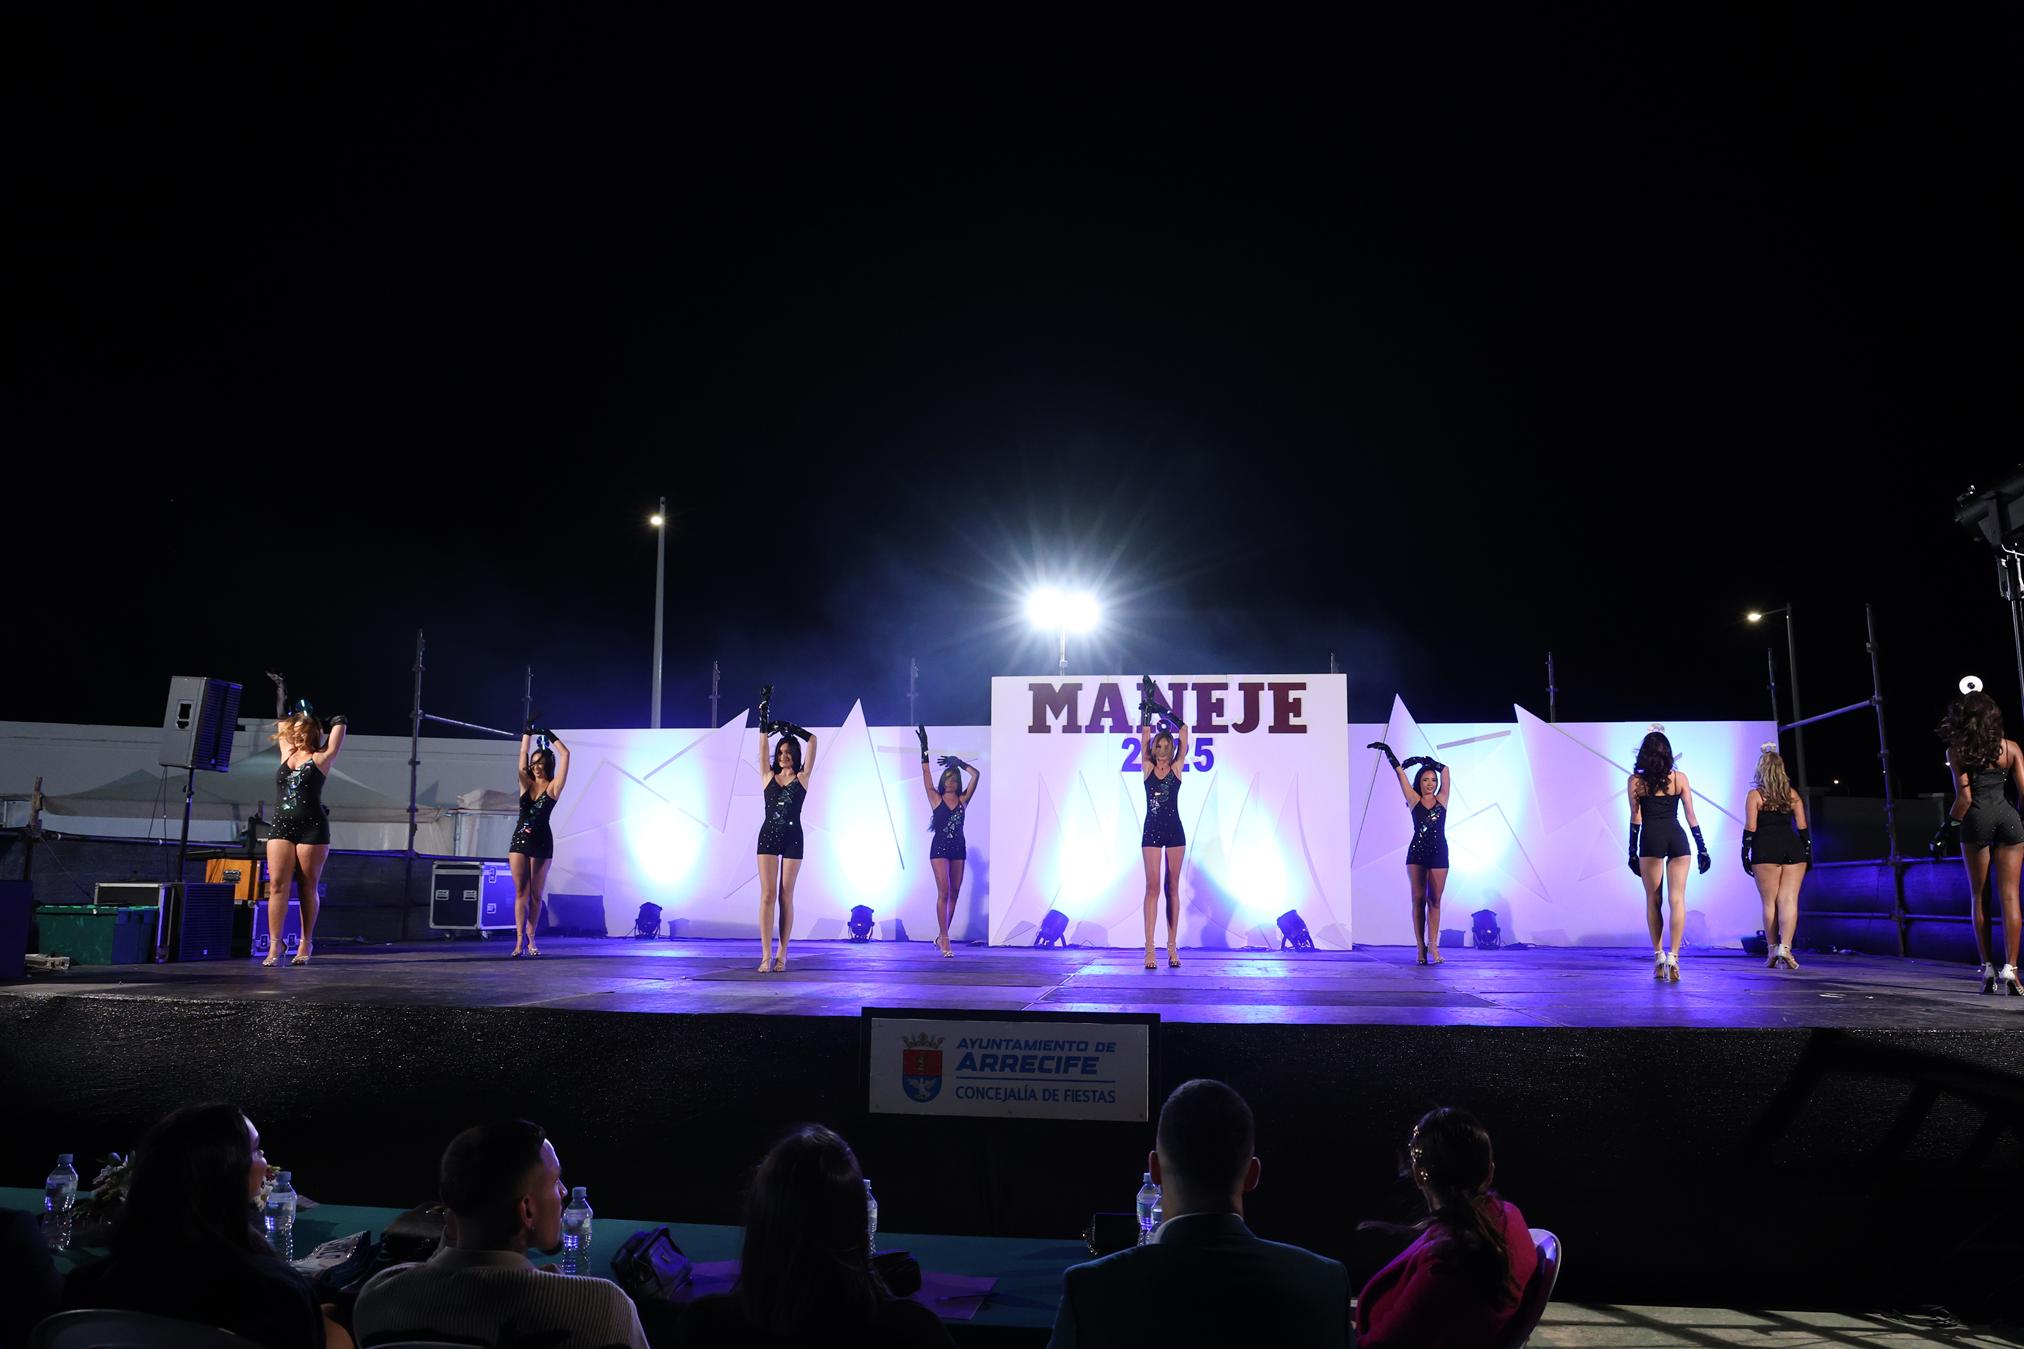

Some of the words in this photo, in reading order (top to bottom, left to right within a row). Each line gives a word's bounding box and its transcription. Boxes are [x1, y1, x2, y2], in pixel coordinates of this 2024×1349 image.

[1028, 682, 1308, 734] MANEJE
[1121, 737, 1215, 773] 25
[956, 1037, 1089, 1052] AYUNTAMIENTO
[1095, 1041, 1117, 1053] DE
[955, 1051, 1100, 1075] ARRECIFE
[955, 1085, 1038, 1102] CONCEJALÍA
[1042, 1088, 1059, 1102] DE
[1064, 1089, 1116, 1104] FIESTAS
